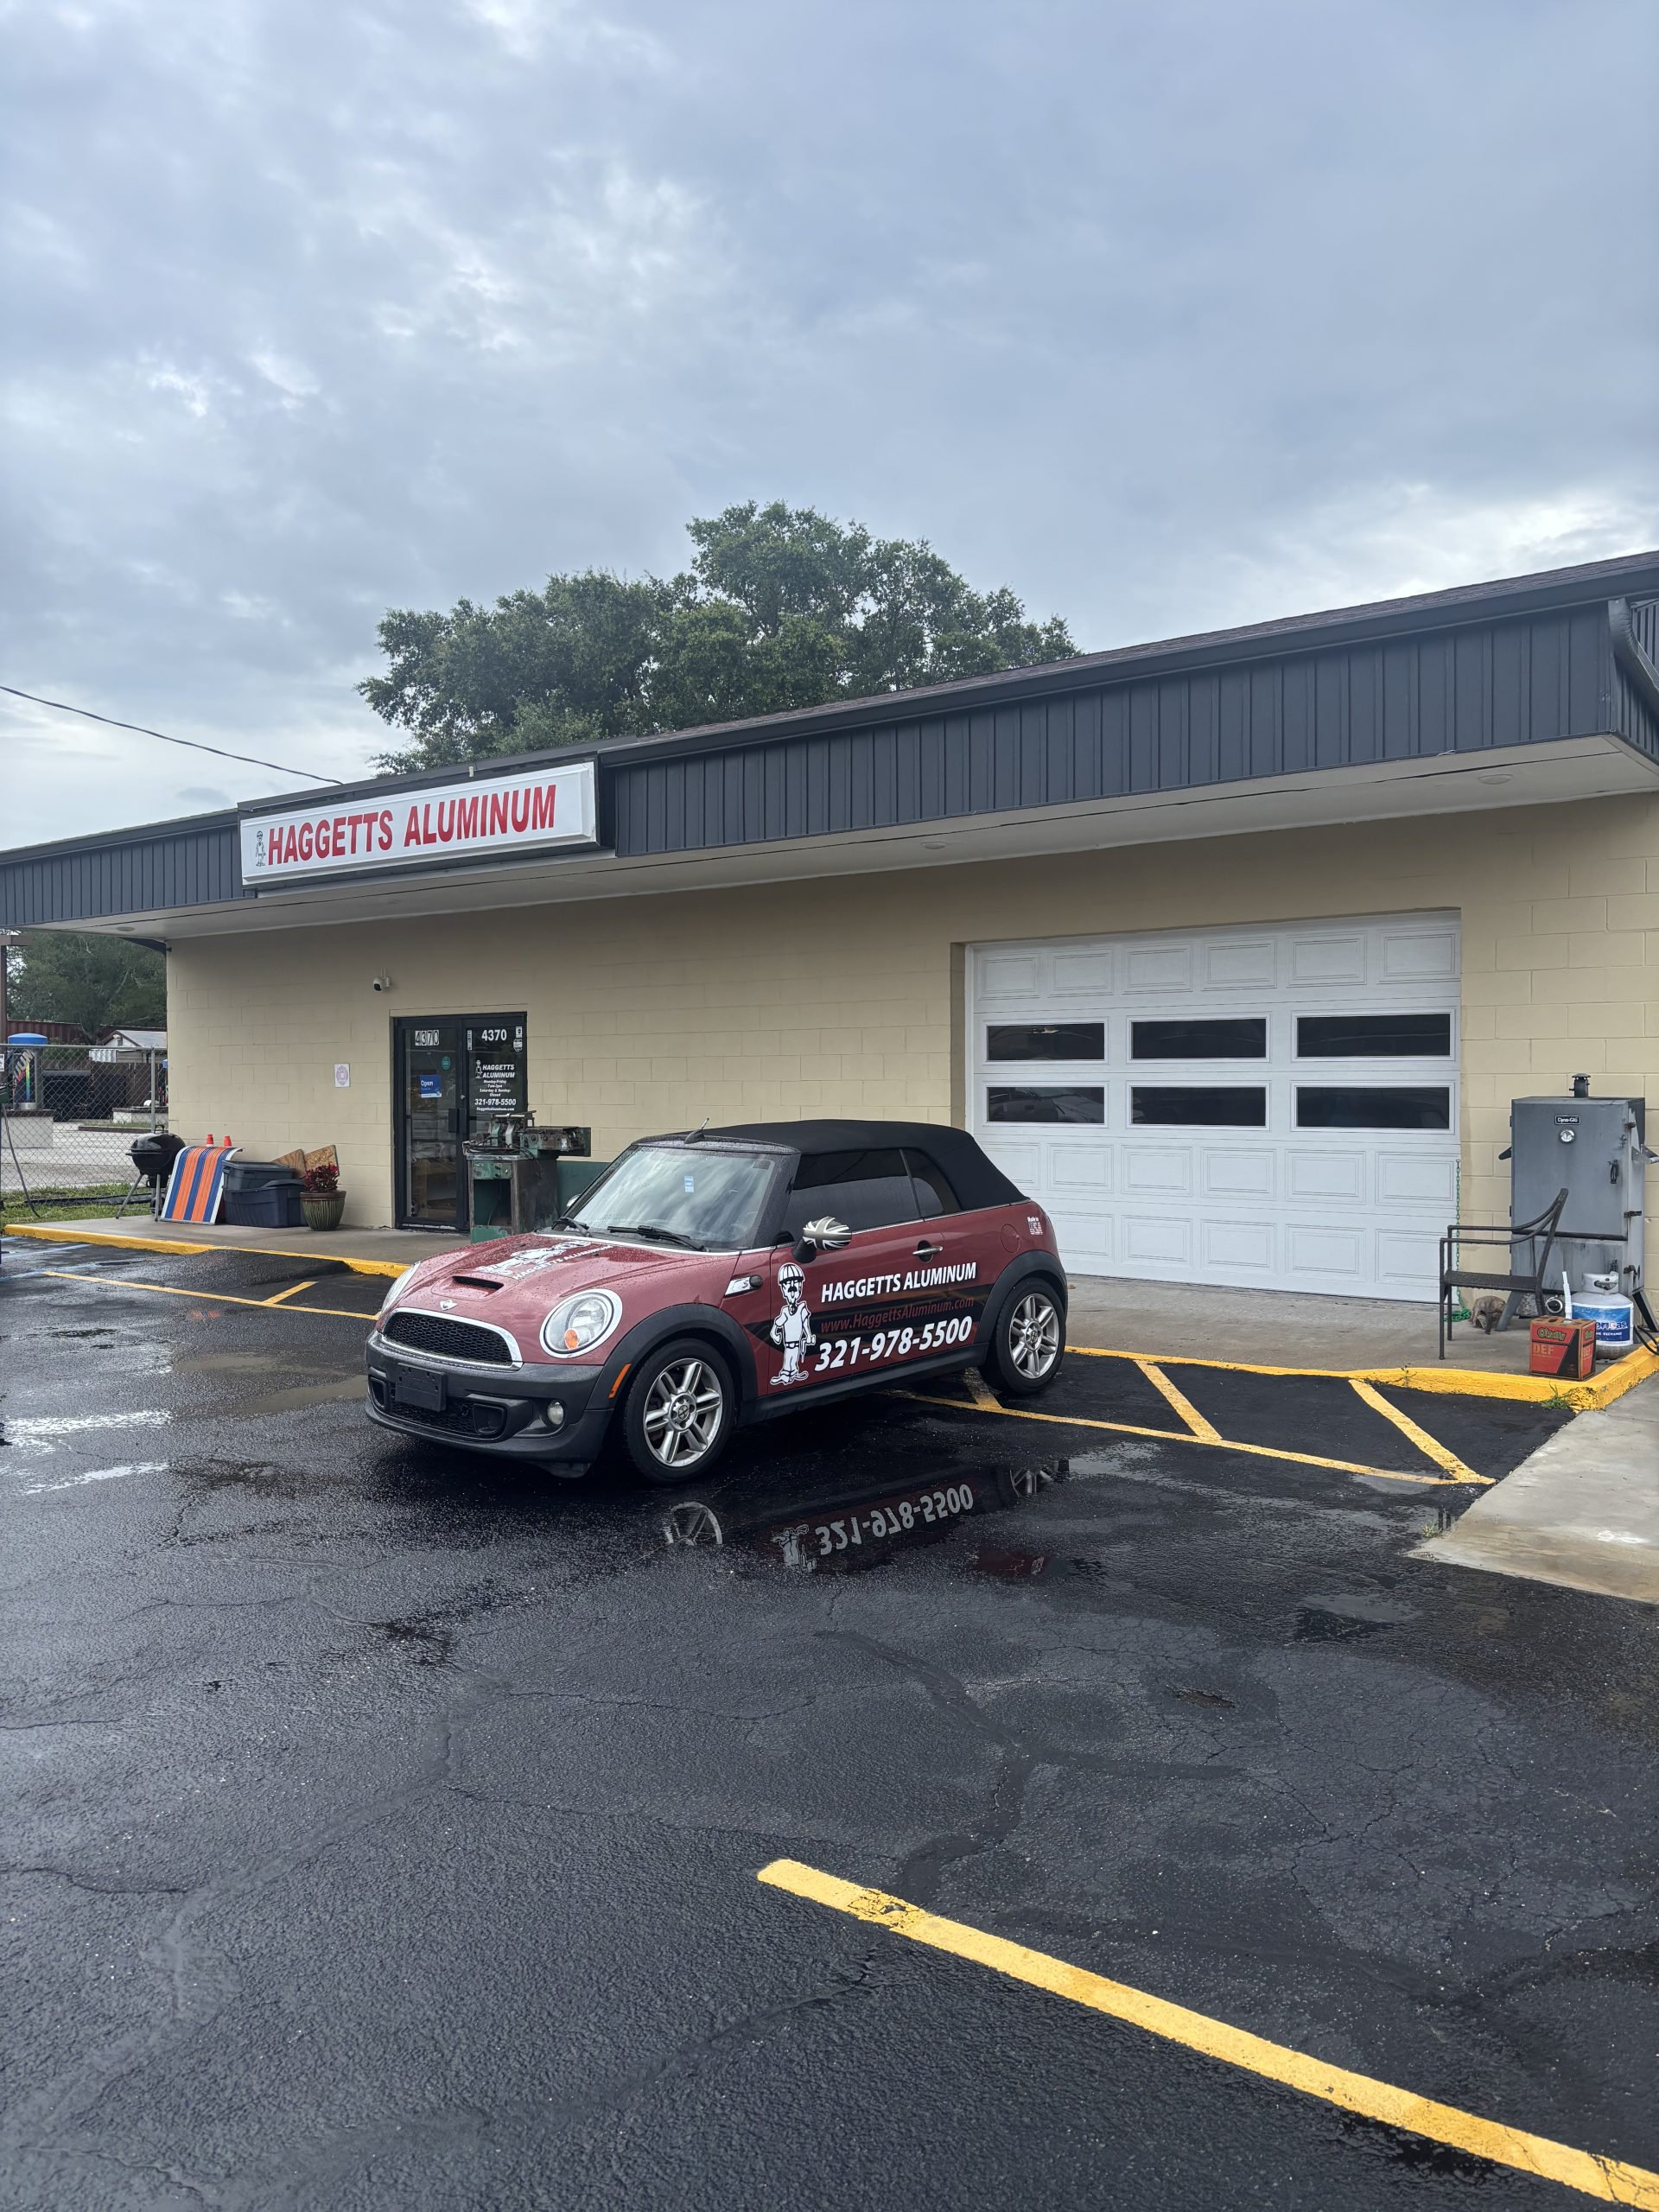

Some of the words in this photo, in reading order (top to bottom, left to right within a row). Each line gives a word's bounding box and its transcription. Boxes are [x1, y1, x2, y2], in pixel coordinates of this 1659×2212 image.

[268, 809, 394, 866] HAGGETTS
[404, 784, 556, 848] ALUMINUM
[415, 1030, 439, 1046] 4370
[481, 1029, 507, 1041] 4370
[512, 1258, 563, 1281] HAGGETTS
[821, 1273, 901, 1303] HAGGETTS
[903, 1262, 976, 1290] ALUMINUM
[821, 1297, 974, 1333] www.HaggettsAluminum.com
[814, 1315, 973, 1372] 321-978-5500
[1533, 1344, 1554, 1355] DEF
